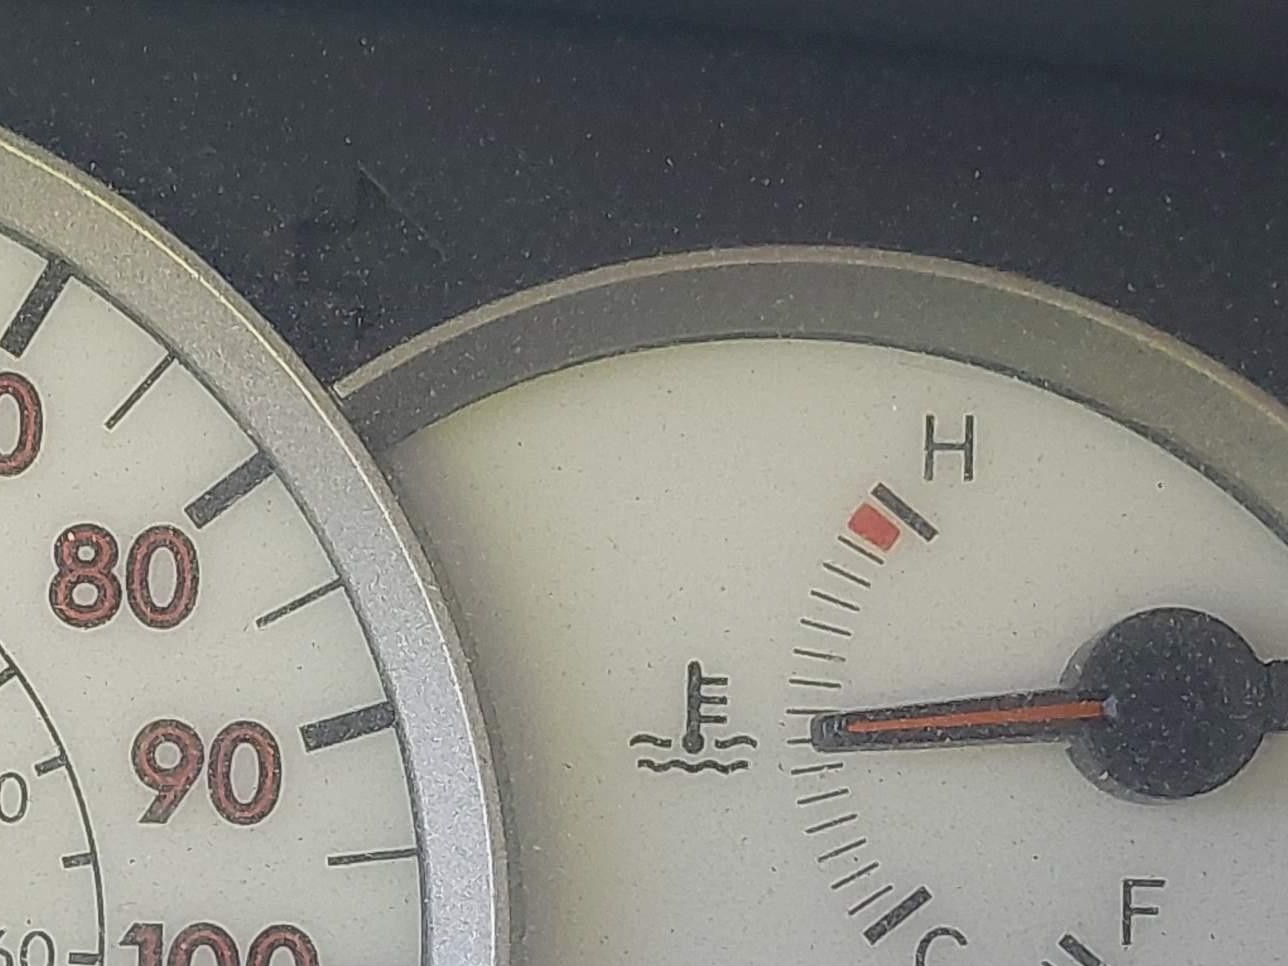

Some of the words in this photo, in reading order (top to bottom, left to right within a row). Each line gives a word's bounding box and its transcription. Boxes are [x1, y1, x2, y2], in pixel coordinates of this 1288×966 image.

[925, 413, 974, 481] H
[49, 523, 200, 628] 80
[130, 719, 282, 826] 90
[1123, 879, 1166, 945] F
